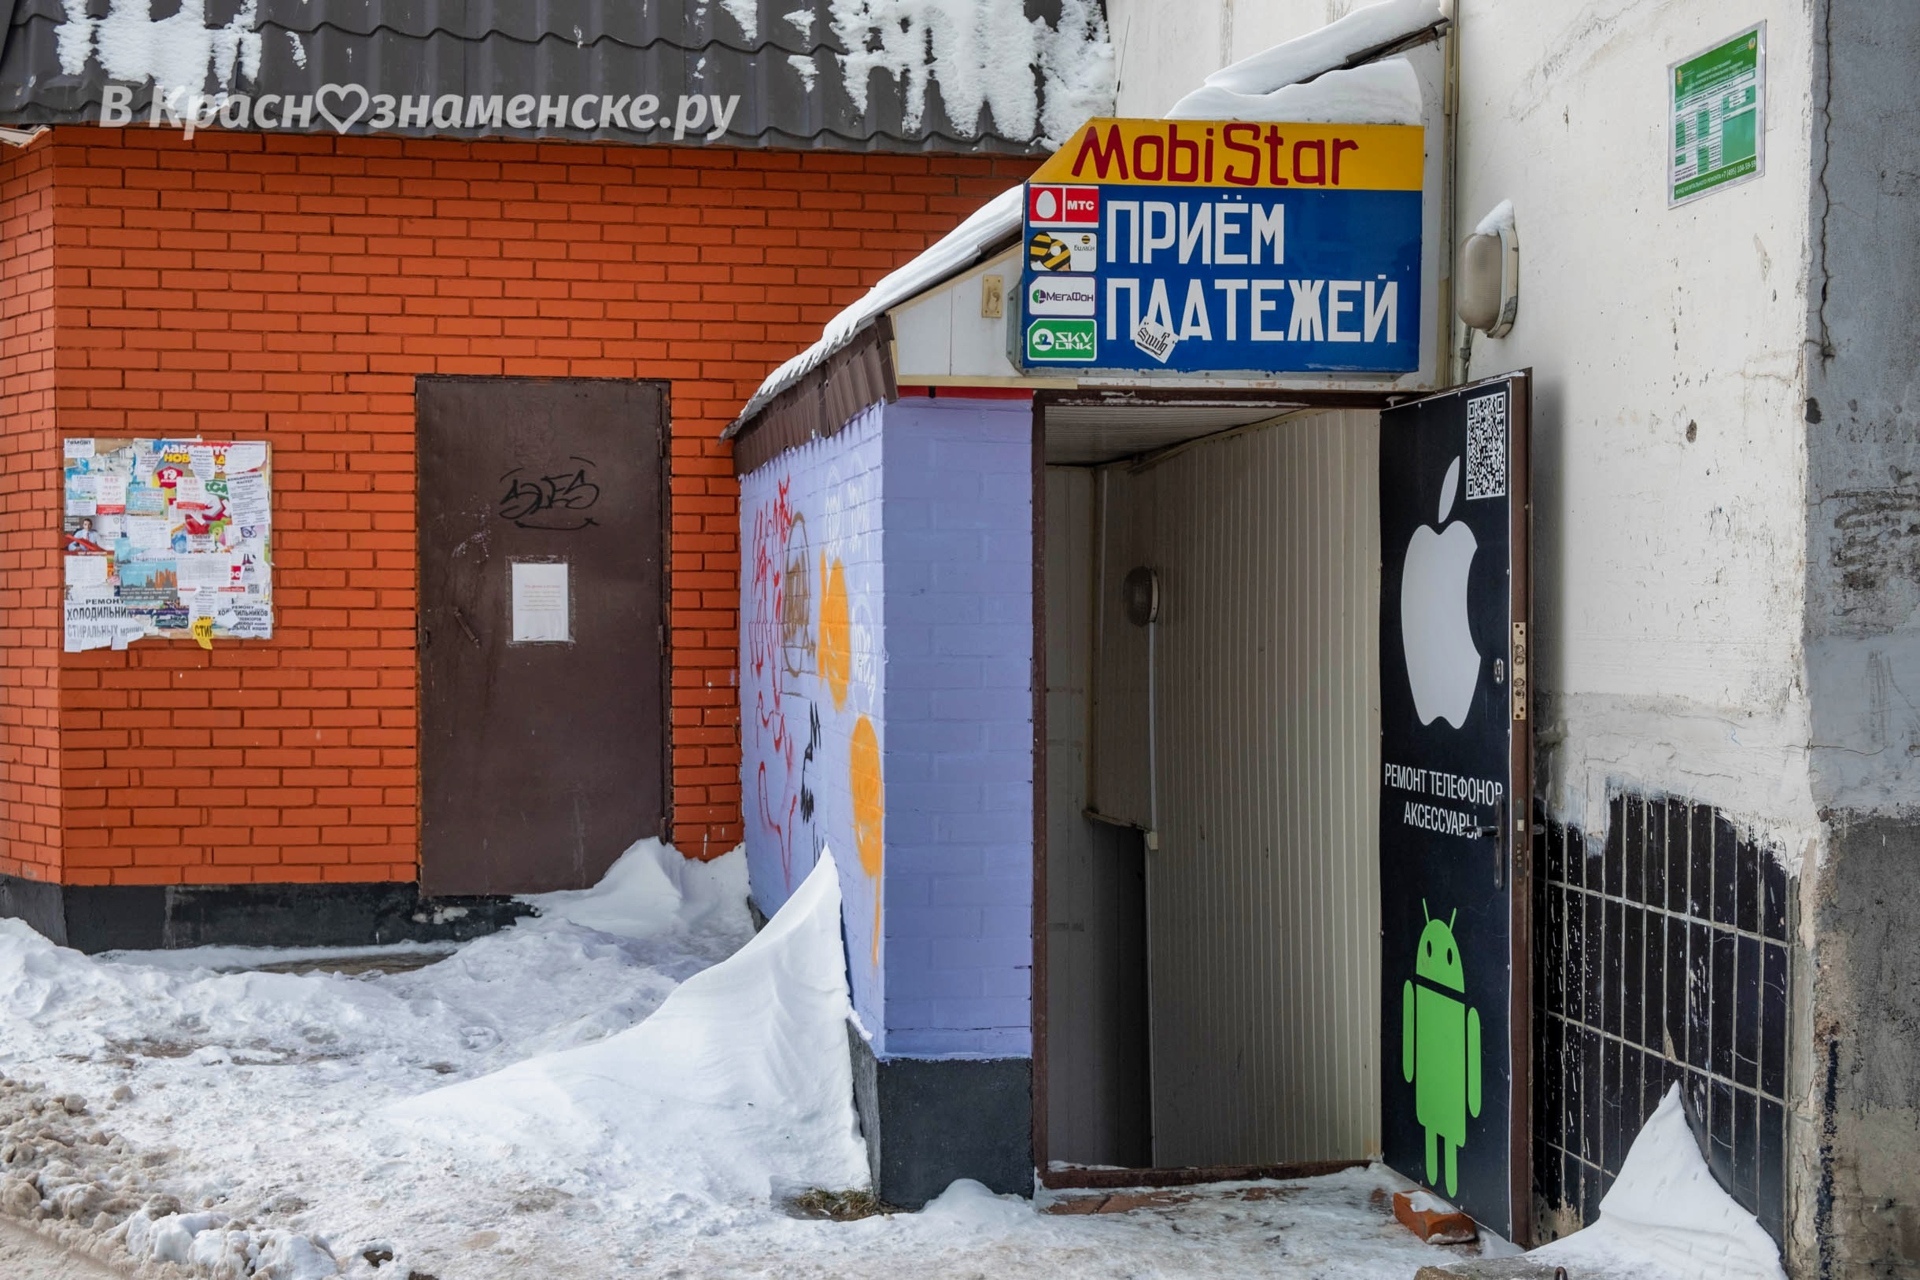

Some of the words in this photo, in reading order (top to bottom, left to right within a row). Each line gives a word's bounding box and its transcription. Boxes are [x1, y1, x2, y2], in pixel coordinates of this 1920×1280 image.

[1071, 123, 1359, 186] MobiStar
[1066, 200, 1095, 211] МТС
[1106, 194, 1285, 265] ПРИЁМ
[1106, 274, 1398, 343] ПЛАТЕЖЕЙ
[1055, 331, 1093, 343] SKY
[1384, 763, 1427, 793] РЕМОНТ
[1403, 801, 1478, 840] АКСЕССУАРЫ
